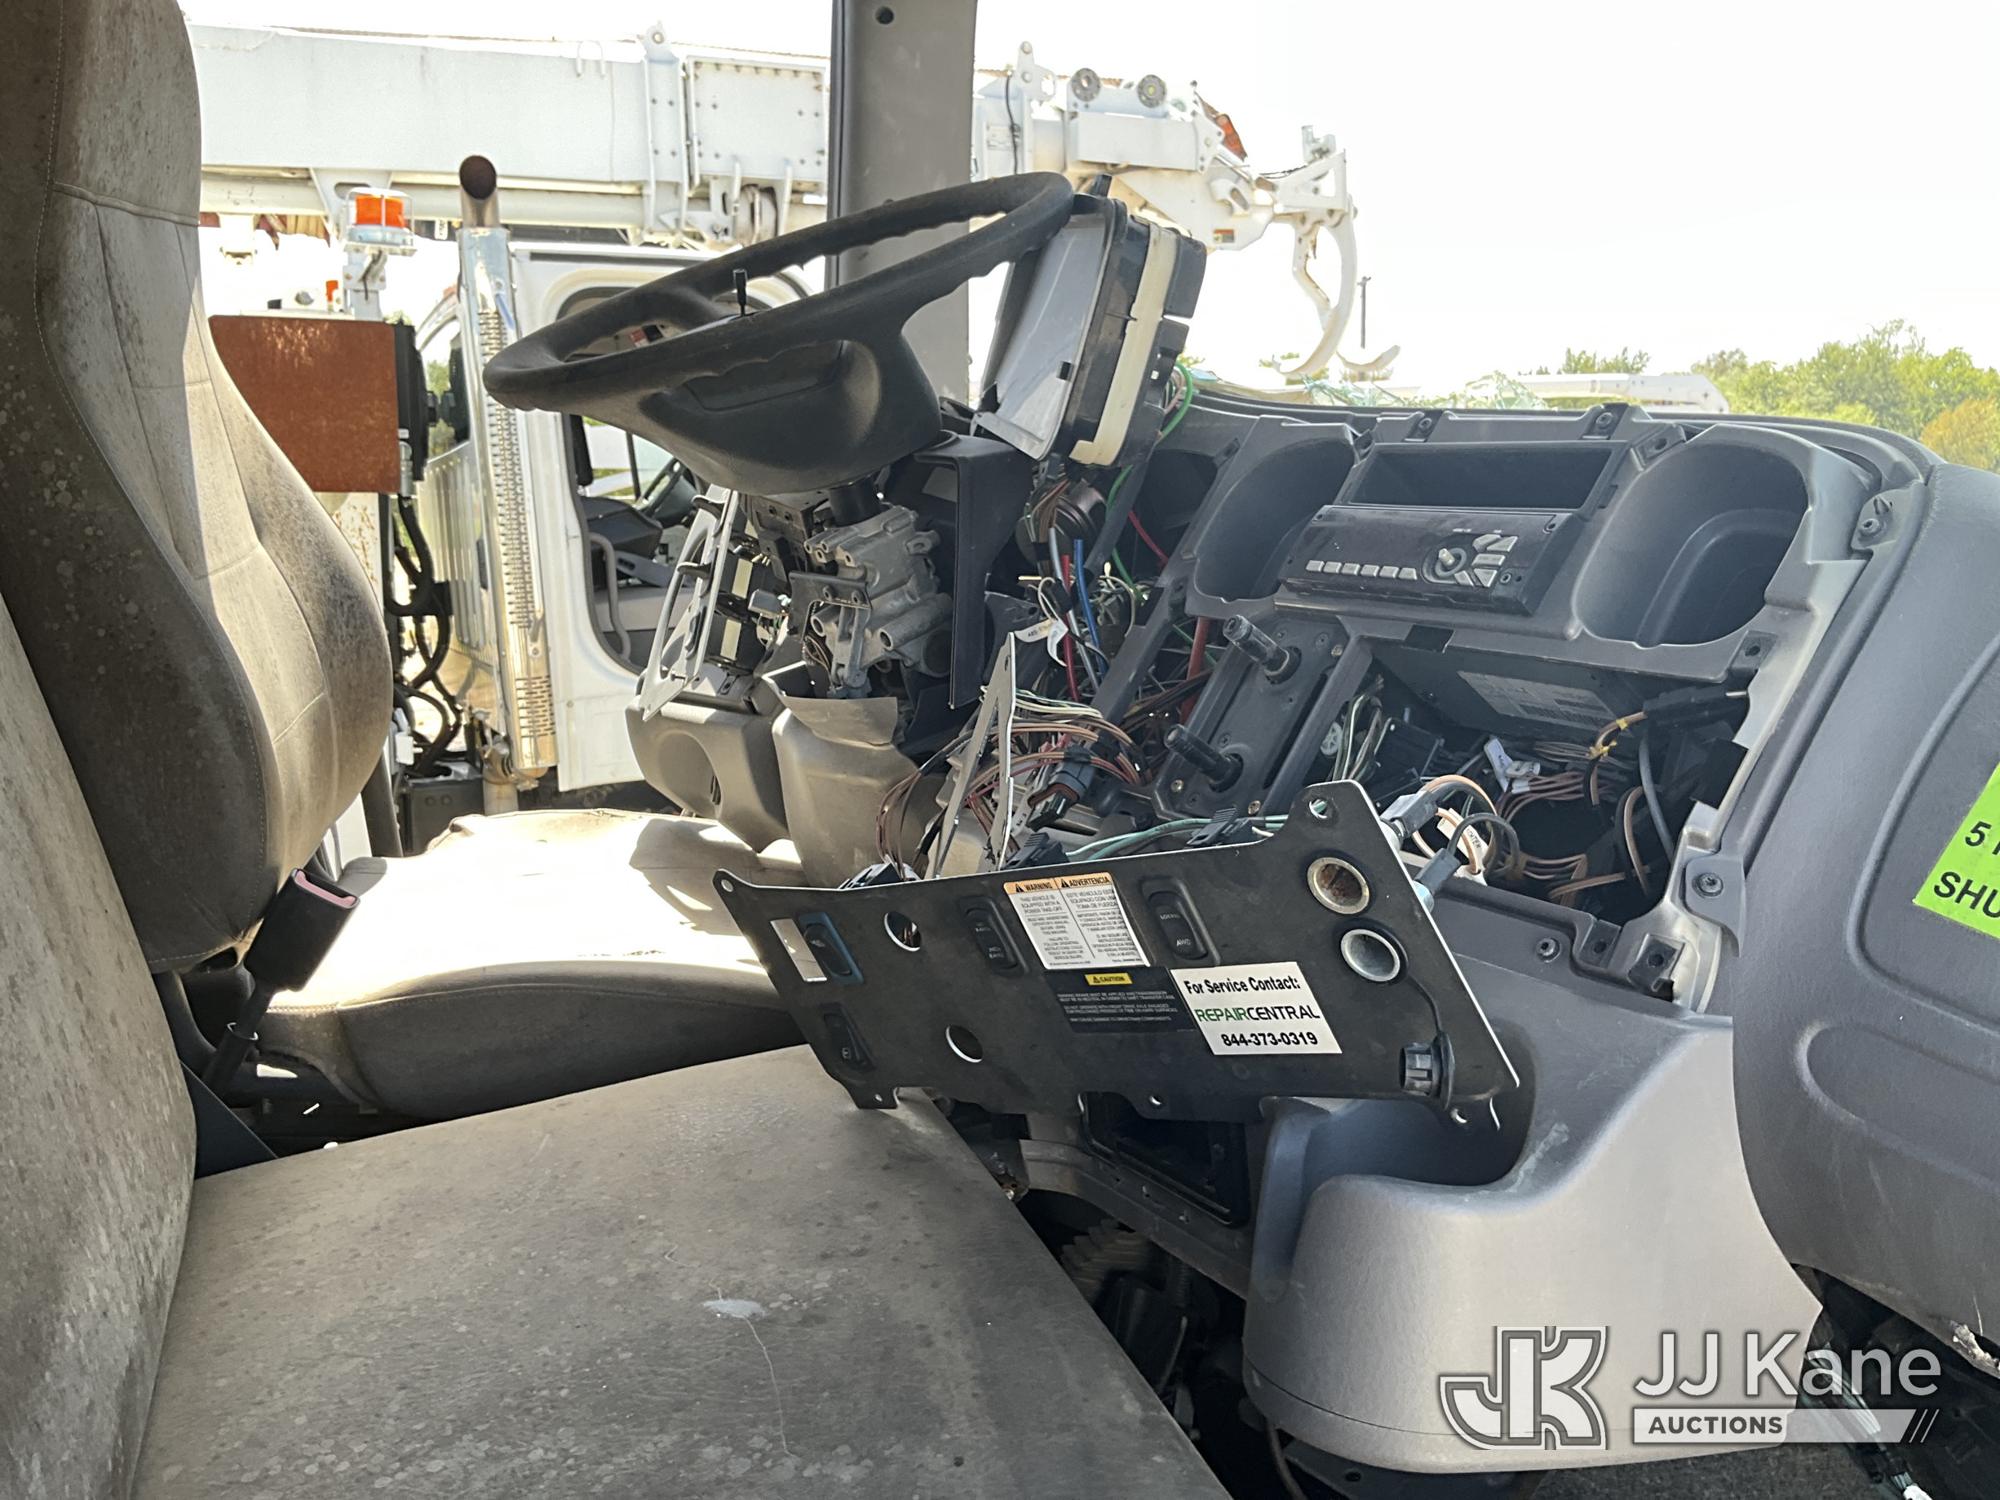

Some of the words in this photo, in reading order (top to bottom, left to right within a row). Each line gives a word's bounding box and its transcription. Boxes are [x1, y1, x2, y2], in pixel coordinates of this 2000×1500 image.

[1965, 820, 1992, 847] 5
[1024, 881, 1053, 891] WARNING
[1068, 876, 1111, 887] ADVERTENCIA
[1184, 979, 1205, 995] For
[1204, 977, 1249, 994] Service
[1249, 975, 1301, 992] Contact:
[1194, 1004, 1321, 1023] REPAIRCENTRAL
[1221, 1031, 1318, 1047] 844-373-0319
